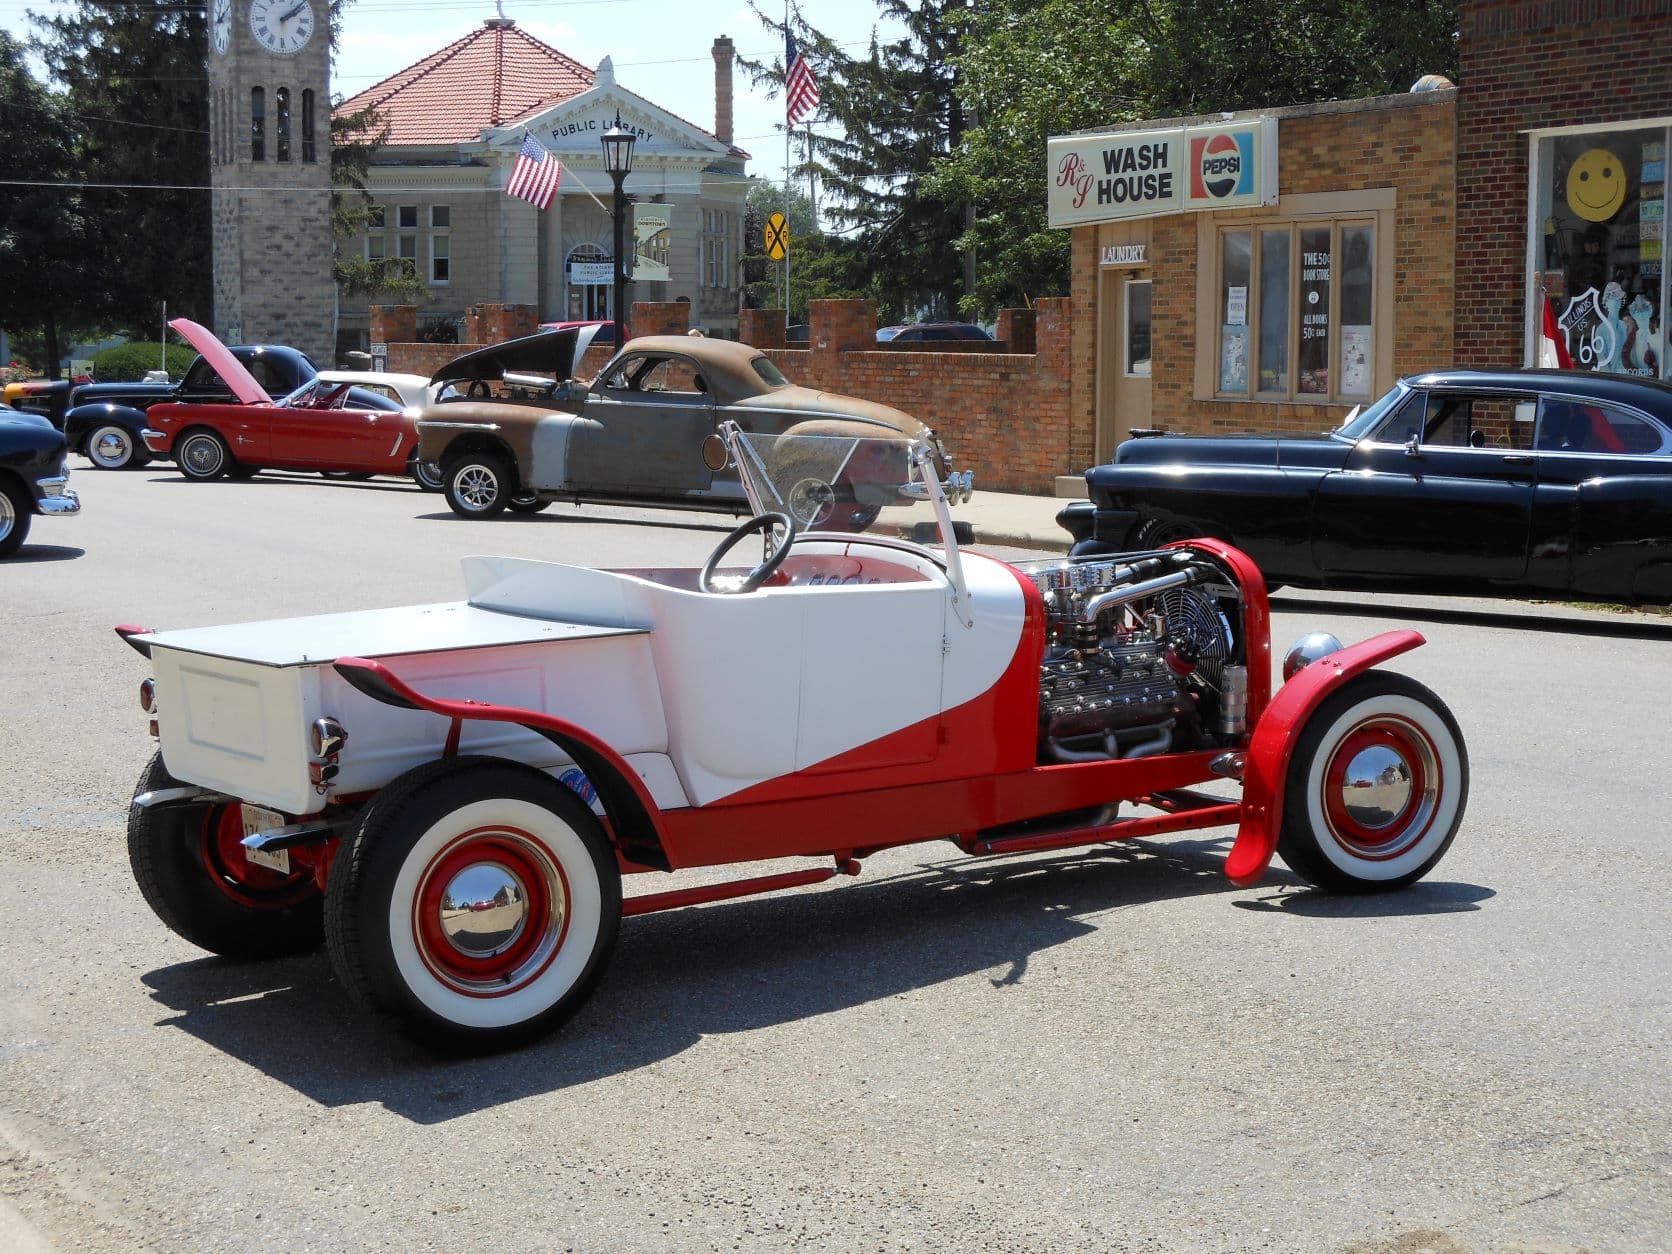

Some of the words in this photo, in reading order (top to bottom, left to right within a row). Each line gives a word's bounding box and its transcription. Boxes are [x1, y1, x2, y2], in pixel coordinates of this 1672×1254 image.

[552, 120, 596, 140] PUBLIC
[1103, 143, 1168, 175] WASH
[1203, 155, 1240, 176] PEPSI
[1097, 172, 1173, 205] HOUSE
[1102, 245, 1146, 262] LAUNDRY
[1303, 252, 1318, 266] THE
[1303, 314, 1312, 325] ALL
[1566, 298, 1592, 326] ILLINOIS
[1577, 319, 1588, 332] US
[1580, 325, 1605, 364] 66
